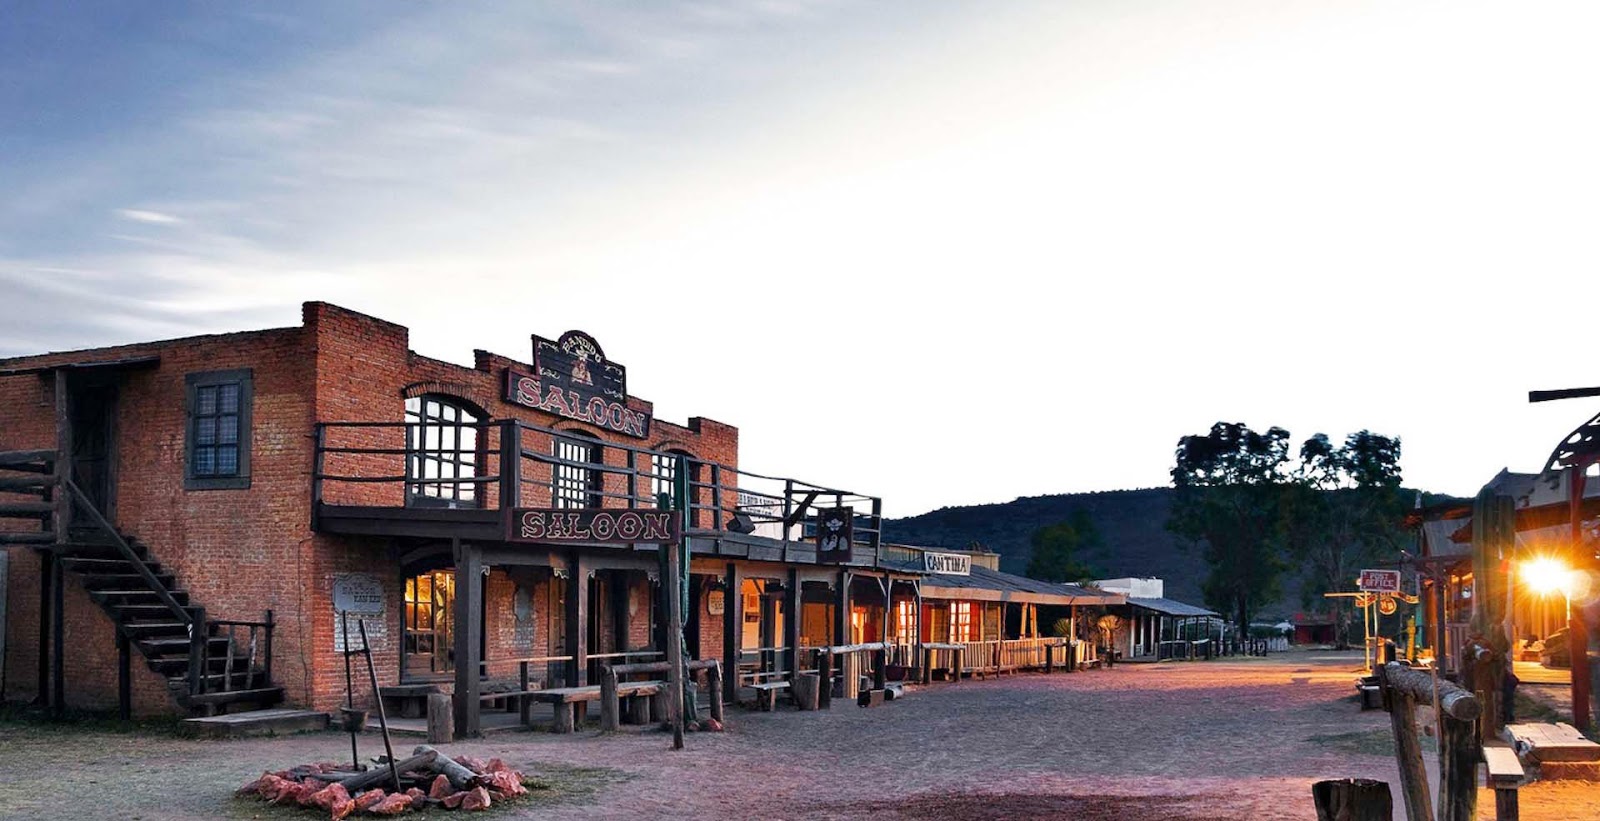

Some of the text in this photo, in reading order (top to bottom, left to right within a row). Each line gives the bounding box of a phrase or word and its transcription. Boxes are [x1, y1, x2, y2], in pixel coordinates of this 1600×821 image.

[562, 335, 602, 363] BANDIDO
[517, 377, 646, 436] SALOON
[522, 511, 671, 540] SALOON
[927, 555, 967, 573] CANTINA
[1366, 579, 1394, 587] OFFICE
